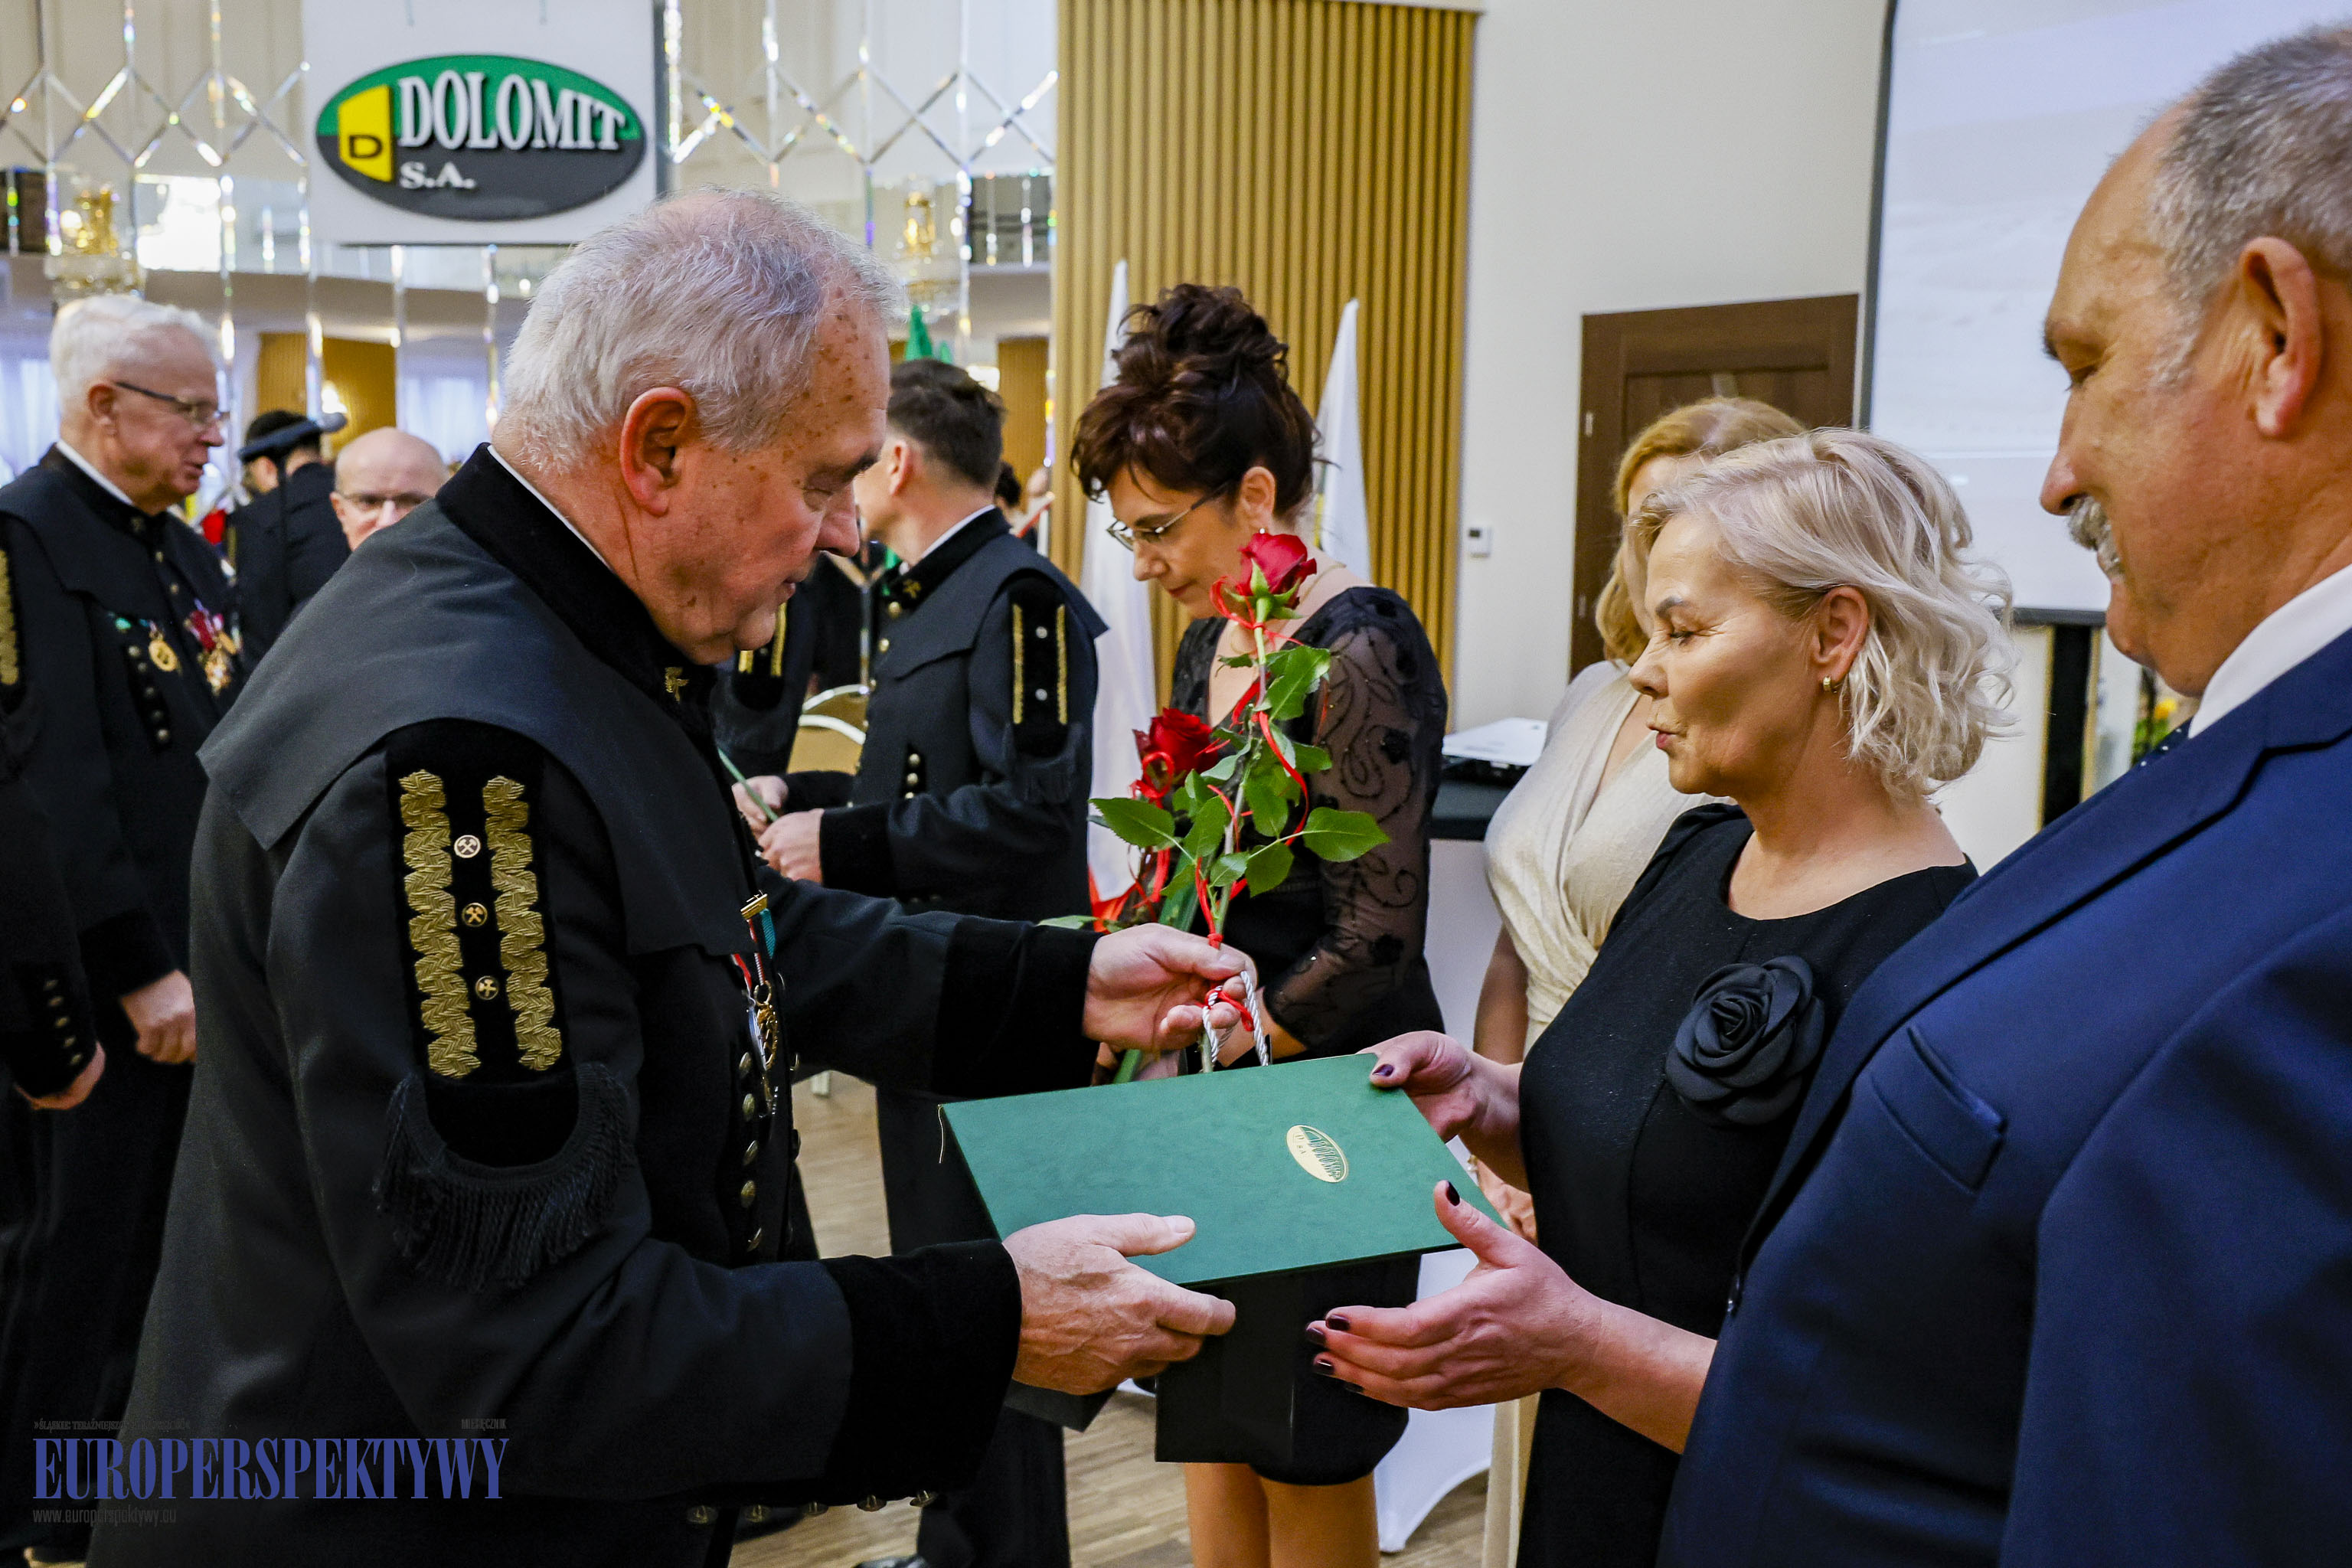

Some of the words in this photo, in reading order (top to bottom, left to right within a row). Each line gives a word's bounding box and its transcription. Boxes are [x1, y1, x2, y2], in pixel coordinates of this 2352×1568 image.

[397, 69, 626, 151] DOLOMIT
[348, 133, 383, 159] D
[398, 161, 477, 189] S.A.
